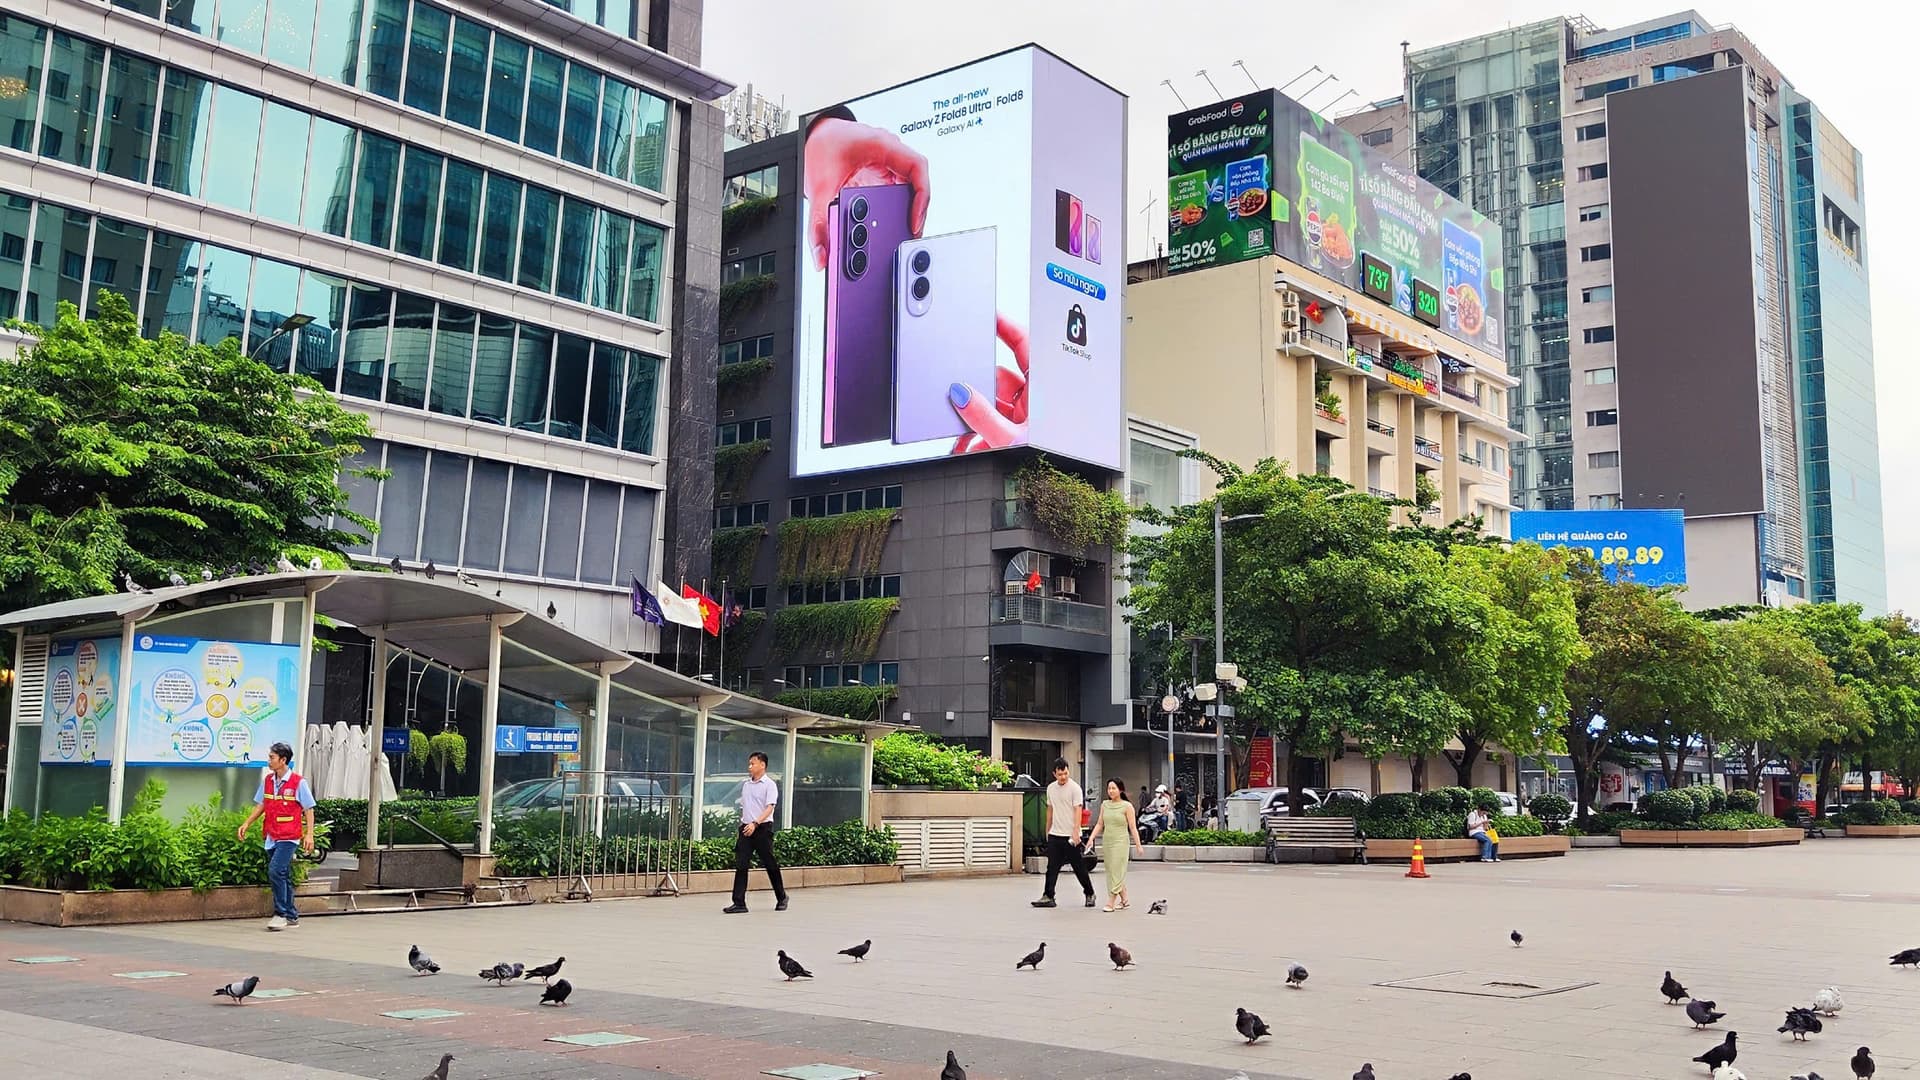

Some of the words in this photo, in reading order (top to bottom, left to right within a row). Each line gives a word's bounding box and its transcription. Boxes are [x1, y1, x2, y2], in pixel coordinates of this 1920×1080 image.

[933, 98, 950, 111] The
[952, 87, 990, 105] all-new
[900, 116, 934, 134] Galaxy
[934, 114, 941, 125] Z
[941, 106, 967, 123] Fold8
[968, 100, 992, 115] Ultra
[996, 89, 1024, 106] Fold8
[1188, 108, 1228, 126] GrabFood
[937, 123, 966, 137] Galaxy
[966, 119, 974, 128] AI
[1382, 162, 1408, 184] GrabFood
[1182, 238, 1217, 261] 50%
[1393, 224, 1420, 259] 50%
[1368, 264, 1390, 292] 737
[1418, 290, 1438, 316] 320
[1062, 343, 1079, 356] TikTok
[1537, 531, 1556, 541] LIÊN
[1557, 530, 1569, 543] HỆ
[1570, 530, 1605, 541] QUẢNG
[1606, 530, 1628, 541] CÁO
